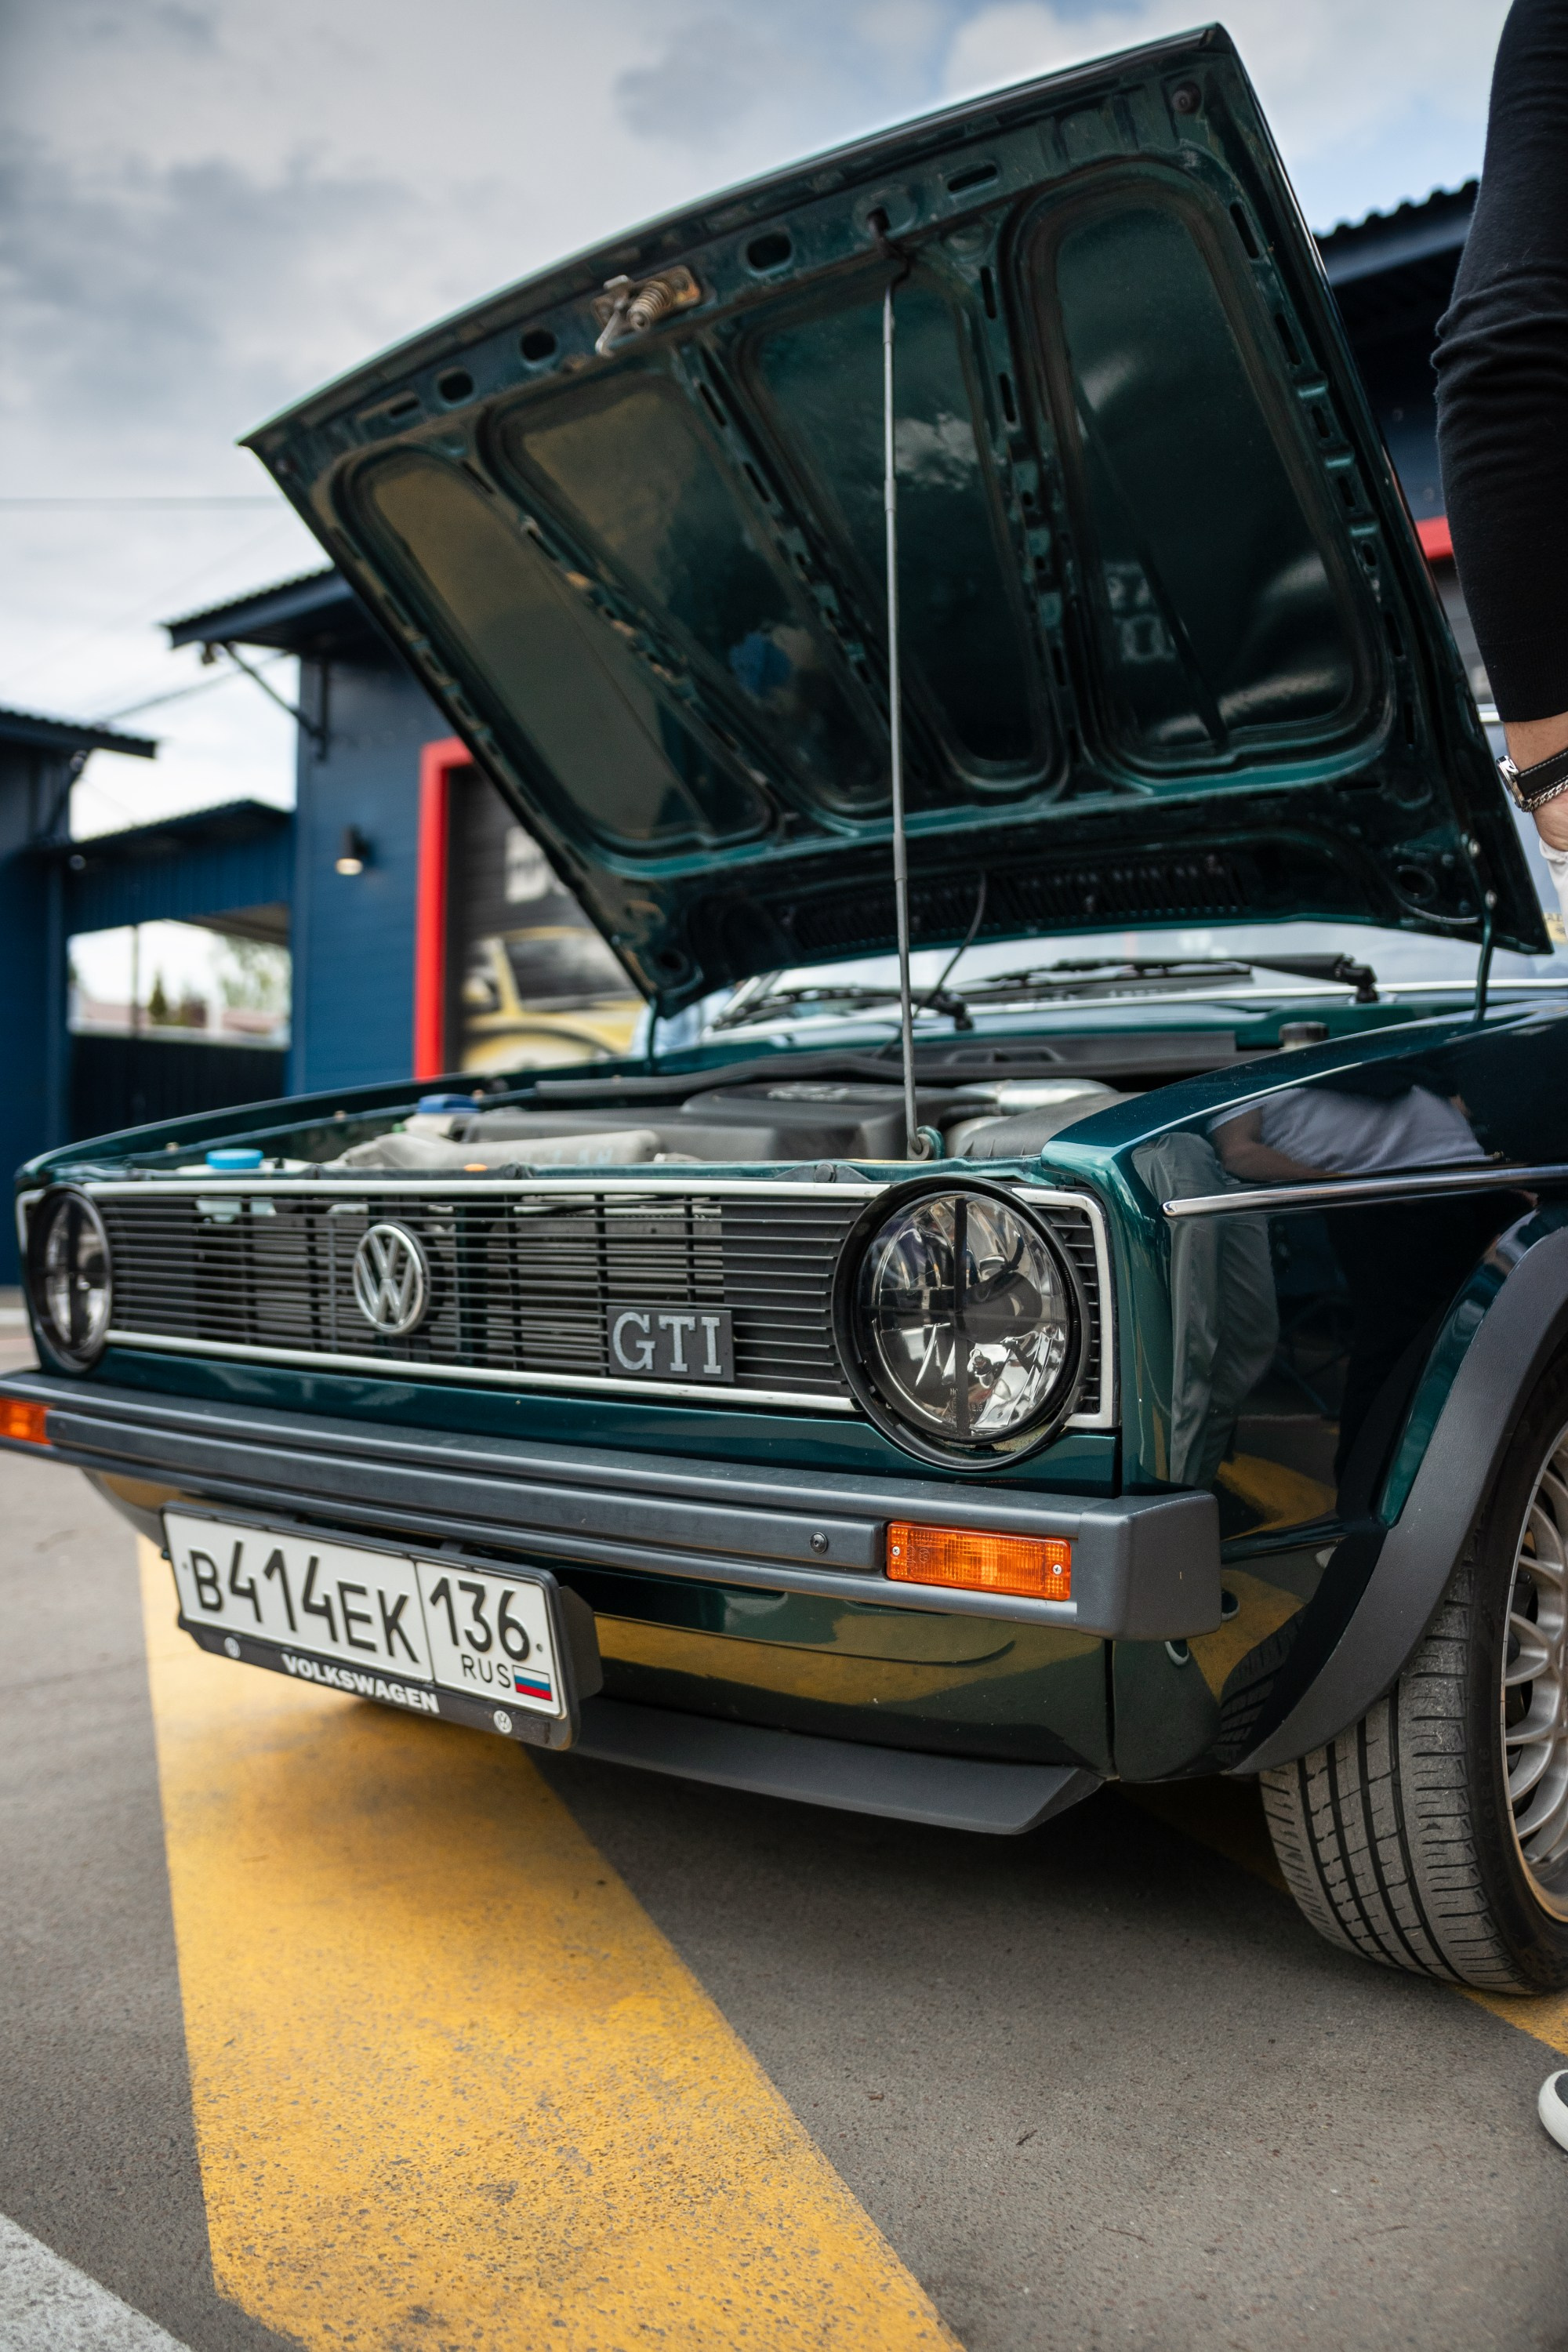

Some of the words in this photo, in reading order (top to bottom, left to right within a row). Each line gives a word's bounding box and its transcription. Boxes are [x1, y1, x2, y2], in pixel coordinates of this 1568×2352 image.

[613, 1312, 721, 1374] GTI
[429, 1576, 531, 1662] 136
[281, 1653, 439, 1714] VOLKSWAGEN
[461, 1653, 511, 1689] RUS
